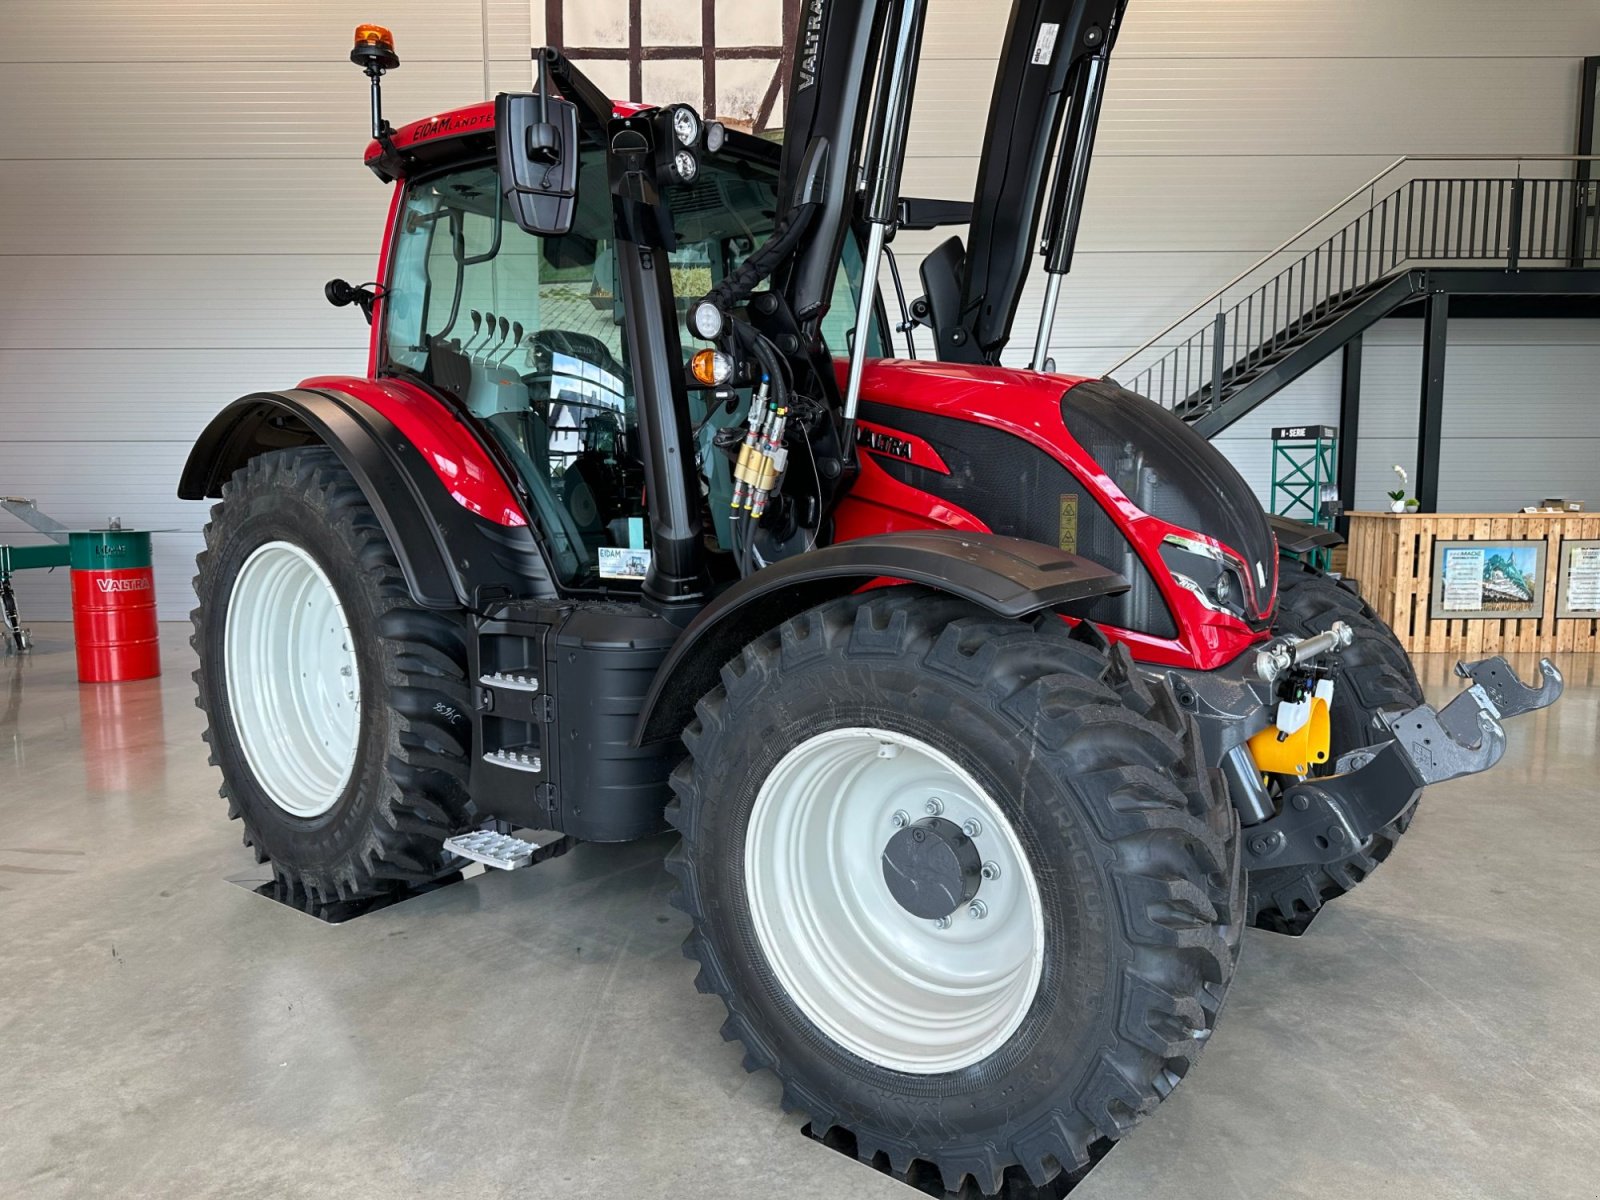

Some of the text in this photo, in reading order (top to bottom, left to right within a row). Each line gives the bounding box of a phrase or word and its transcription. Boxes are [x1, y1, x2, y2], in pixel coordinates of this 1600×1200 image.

[798, 0, 824, 92] VALTRA
[413, 114, 496, 141] EIDAM LANDTE
[600, 549, 621, 559] EIDAM
[96, 578, 151, 592] VALTRA
